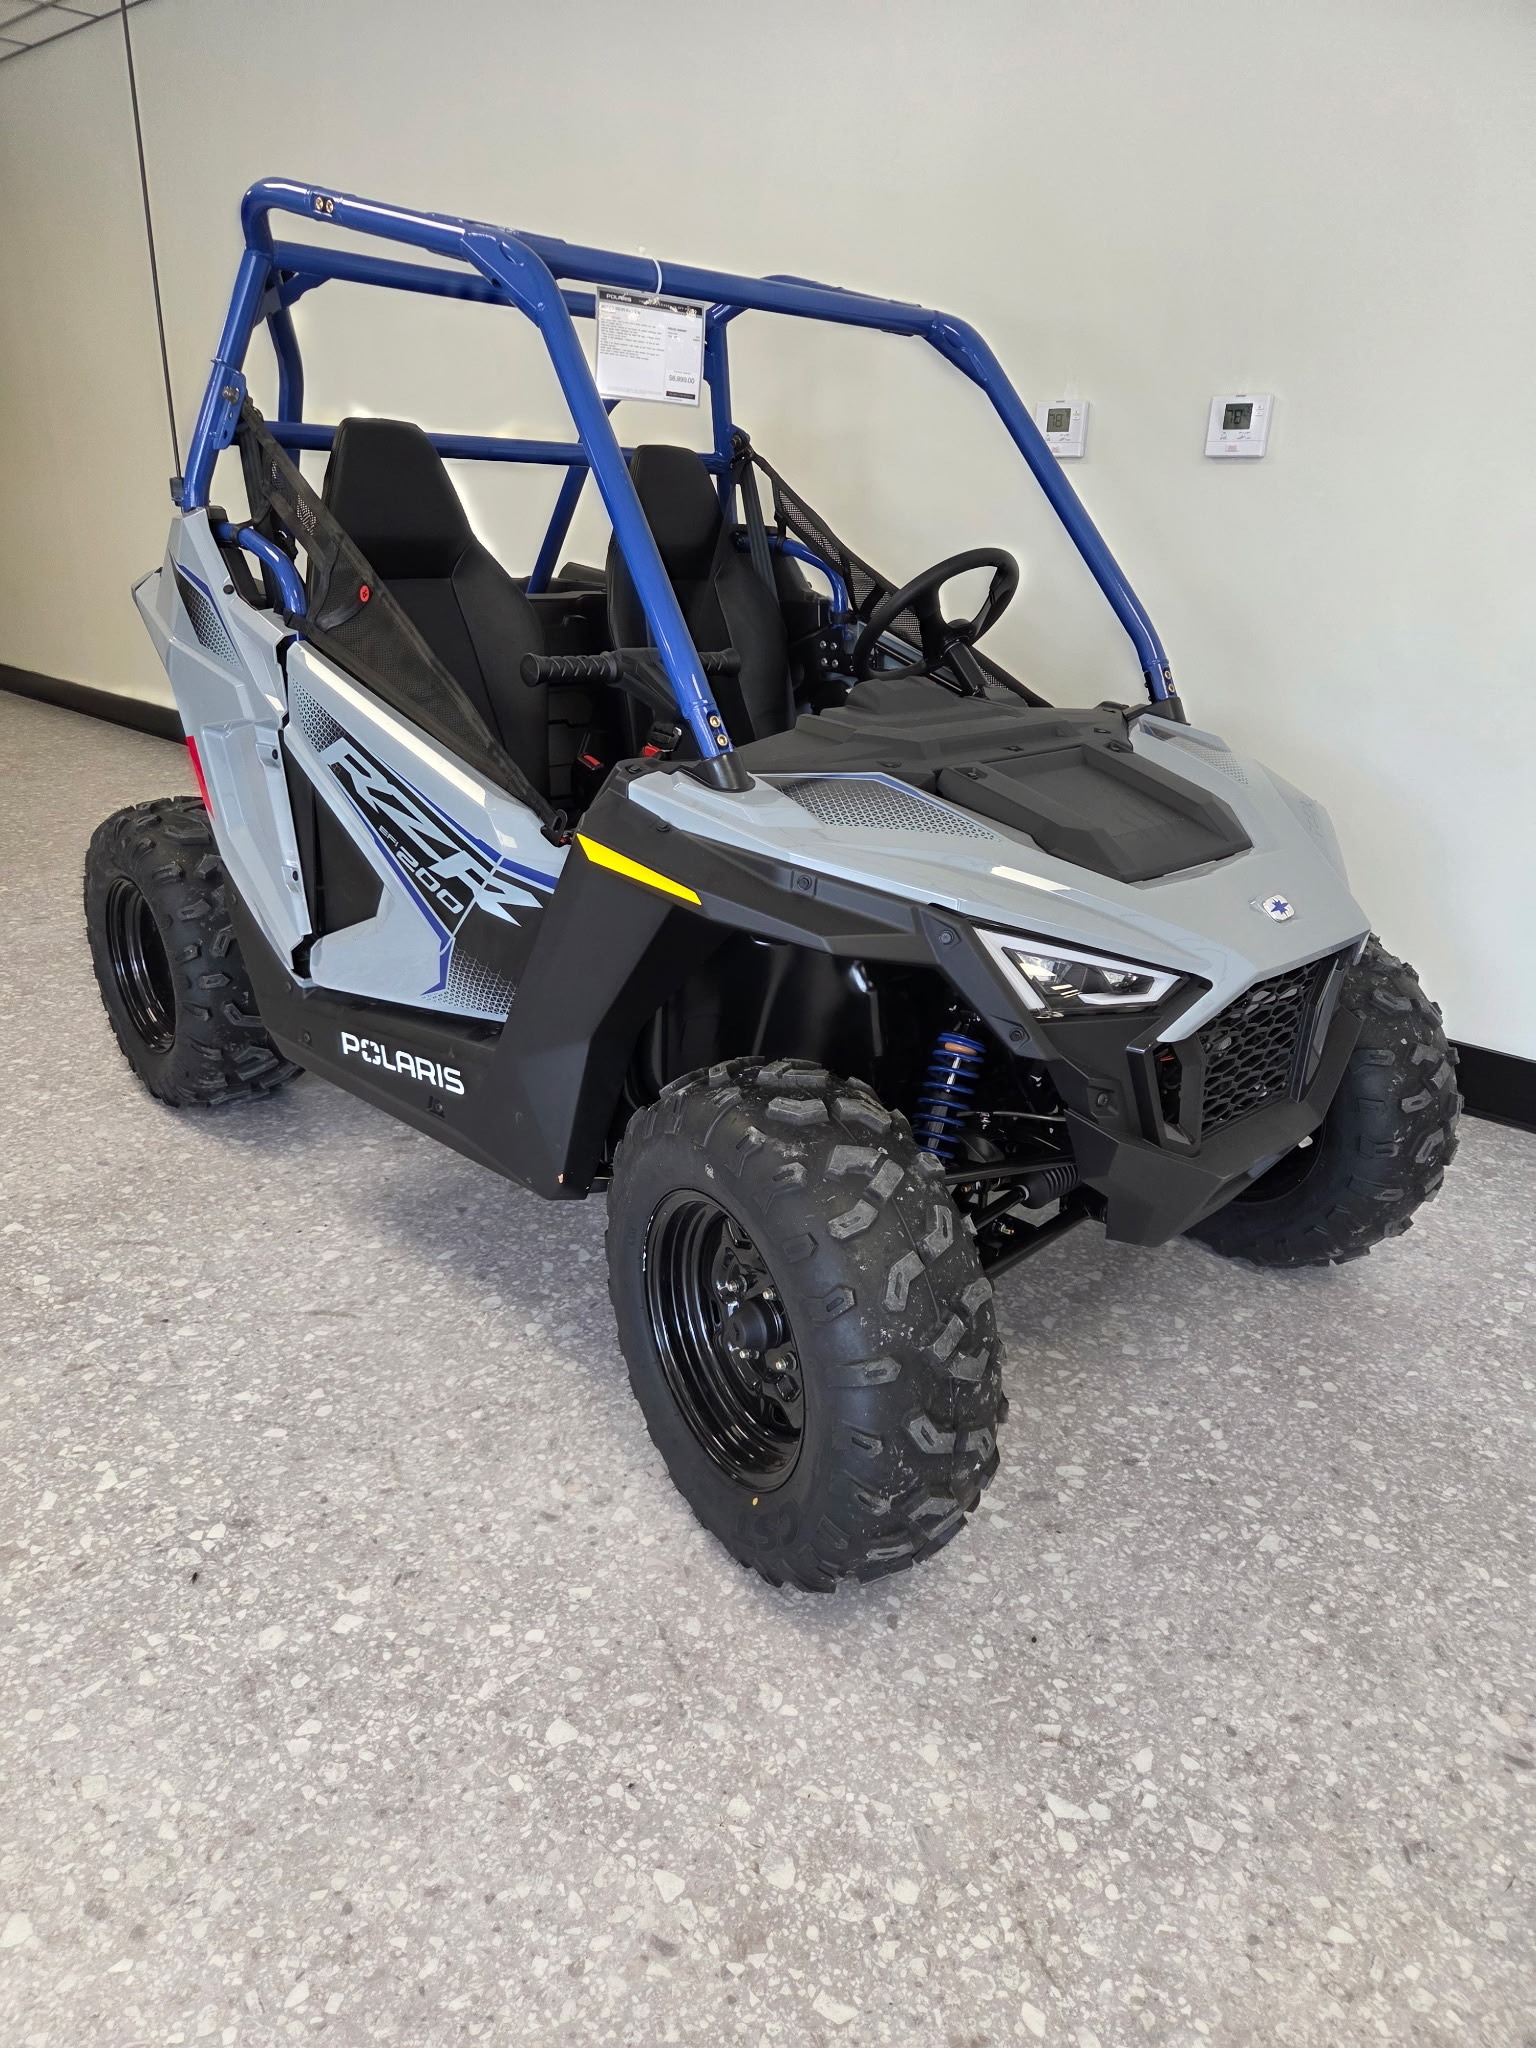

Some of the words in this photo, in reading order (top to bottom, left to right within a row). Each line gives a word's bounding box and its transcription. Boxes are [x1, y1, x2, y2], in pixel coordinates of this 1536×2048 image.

[1049, 413, 1064, 428] 78
[1226, 409, 1243, 425] 78
[318, 736, 544, 928] RZR
[377, 824, 400, 848] EFI
[396, 845, 464, 915] 200
[340, 1031, 465, 1095] POLARIS
